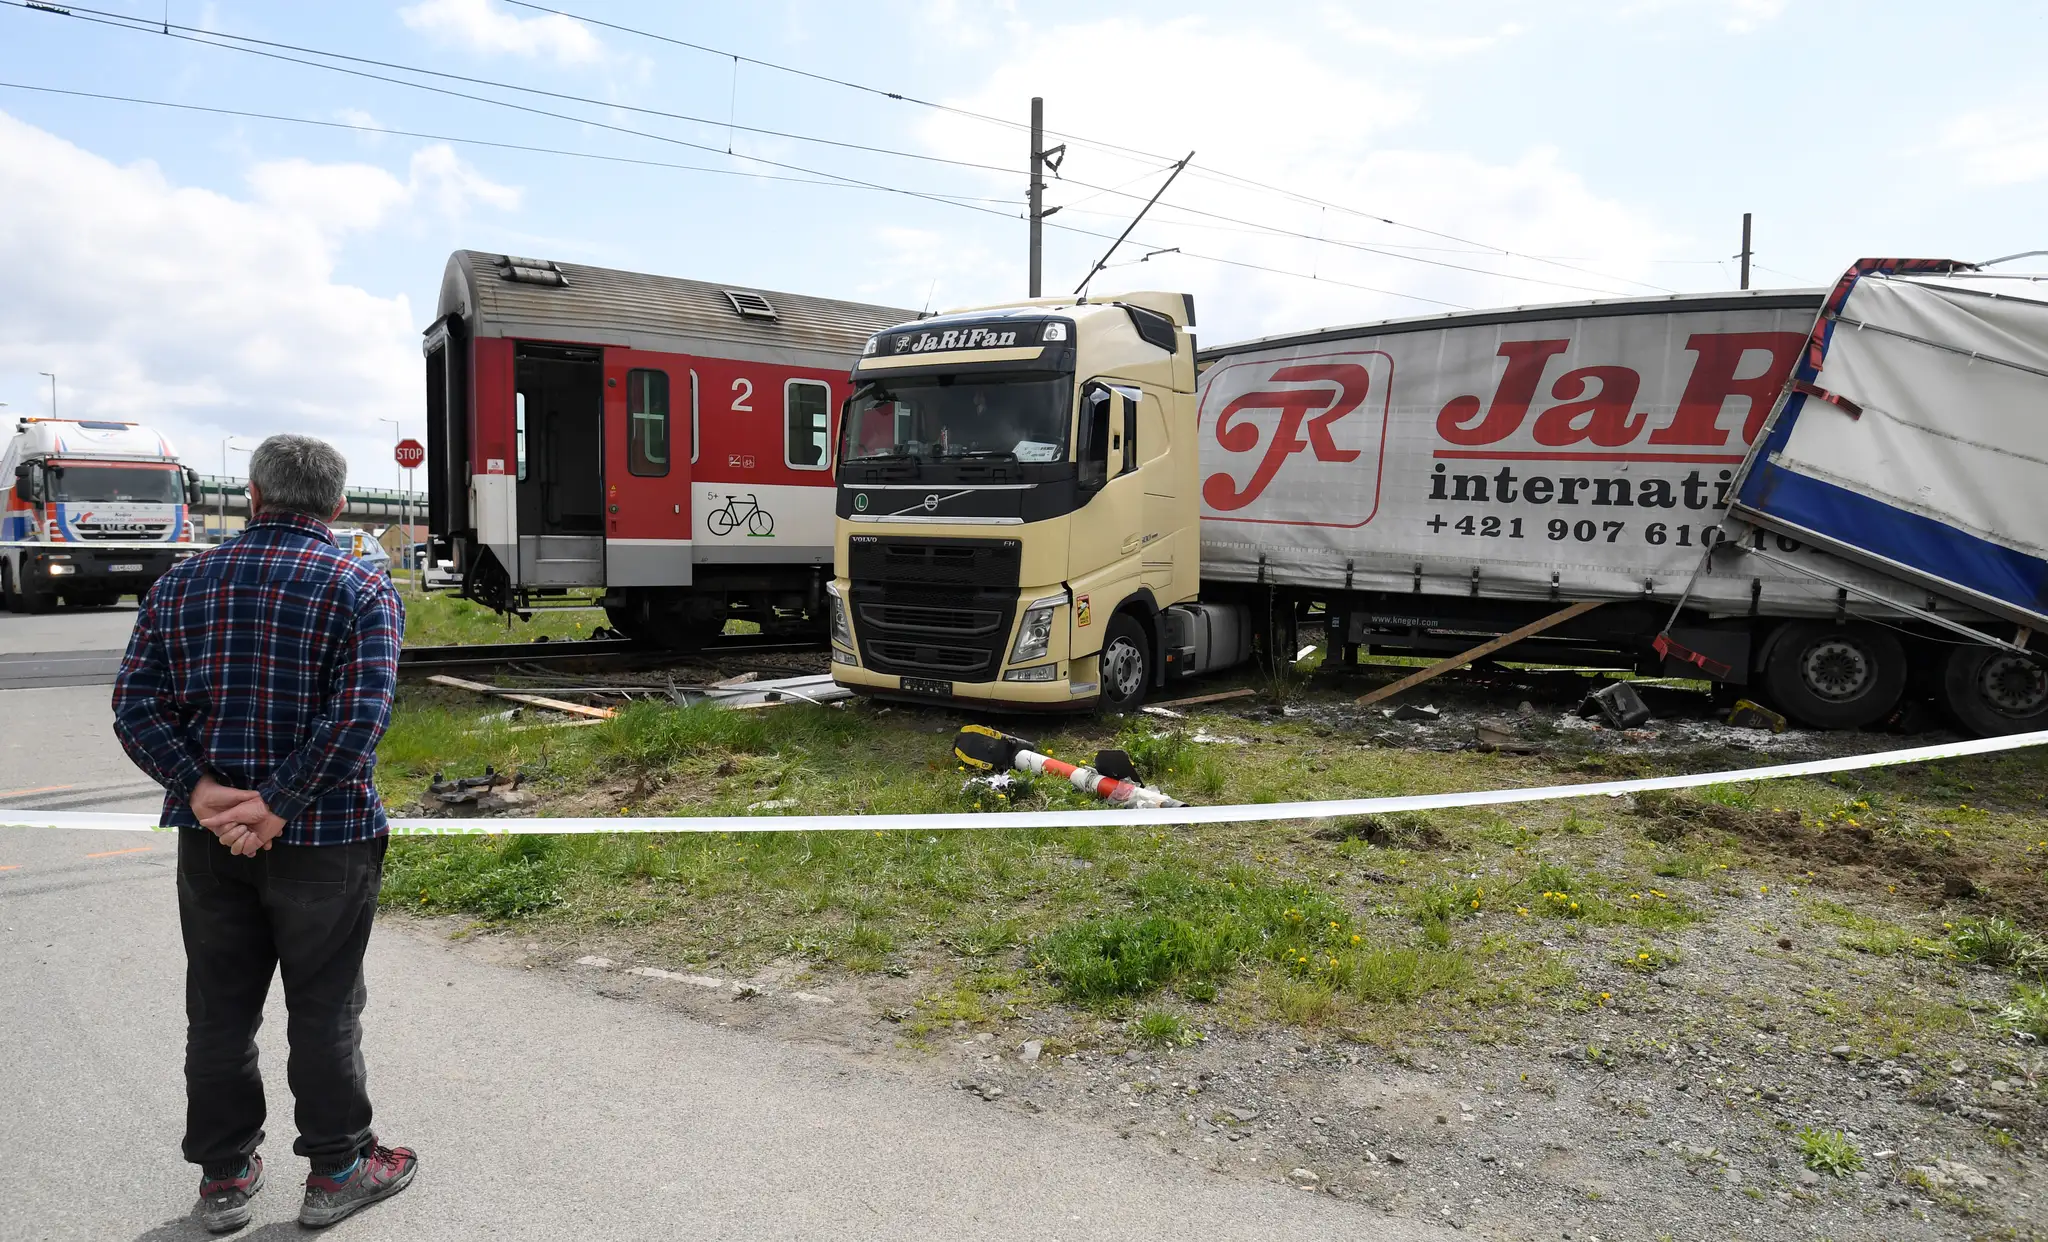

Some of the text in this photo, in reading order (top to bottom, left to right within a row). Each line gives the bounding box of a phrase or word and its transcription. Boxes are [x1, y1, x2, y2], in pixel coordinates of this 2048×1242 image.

[911, 328, 1016, 352] JaRiFan
[731, 378, 753, 412] 2
[1436, 331, 1806, 447] JaR
[396, 447, 423, 460] STOP
[1428, 463, 1733, 510] internati
[100, 523, 146, 533] IVECO
[1426, 514, 1524, 539] +421
[1547, 519, 1625, 544] 907
